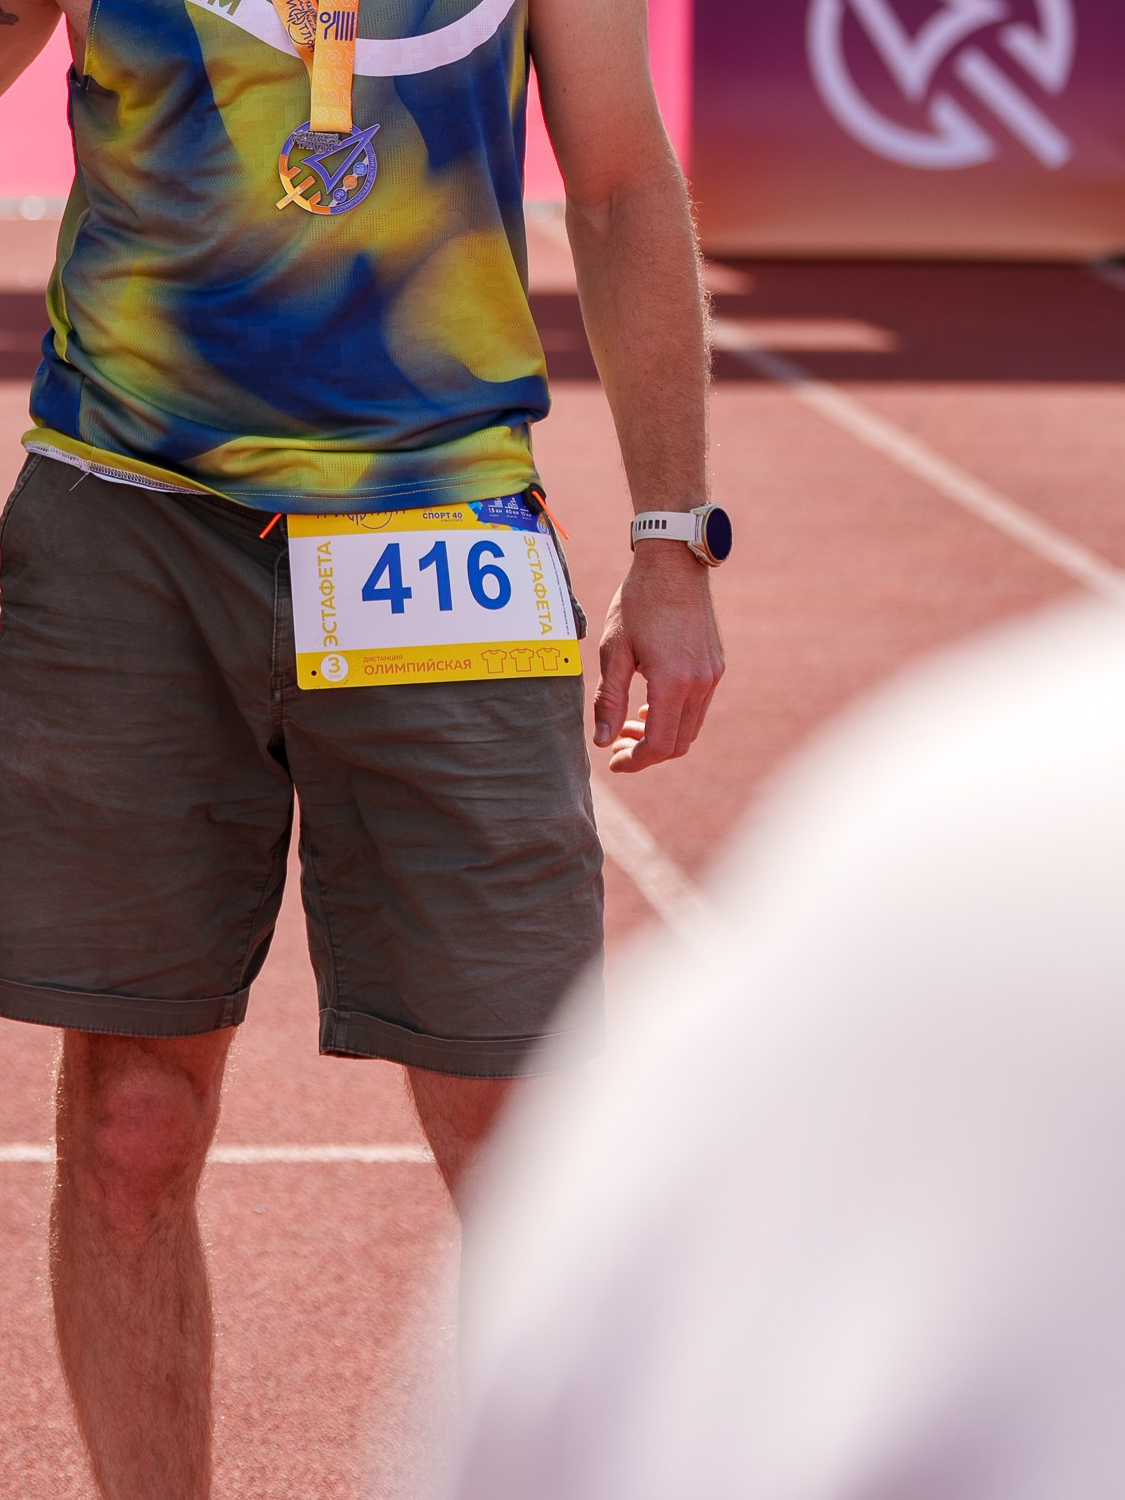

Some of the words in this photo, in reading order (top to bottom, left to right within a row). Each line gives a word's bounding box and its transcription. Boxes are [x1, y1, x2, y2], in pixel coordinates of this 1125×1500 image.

[422, 512, 451, 520] СПОРТ
[452, 511, 463, 519] 40
[361, 540, 512, 614] 416
[523, 535, 553, 635] ЭСТАФЕТА
[316, 540, 339, 647] ЭСТАФЕТА
[328, 657, 341, 673] 3
[363, 654, 403, 663] ДИСТАНЦИЯ
[364, 658, 472, 676] ОЛИМПИЙСКАЯ
